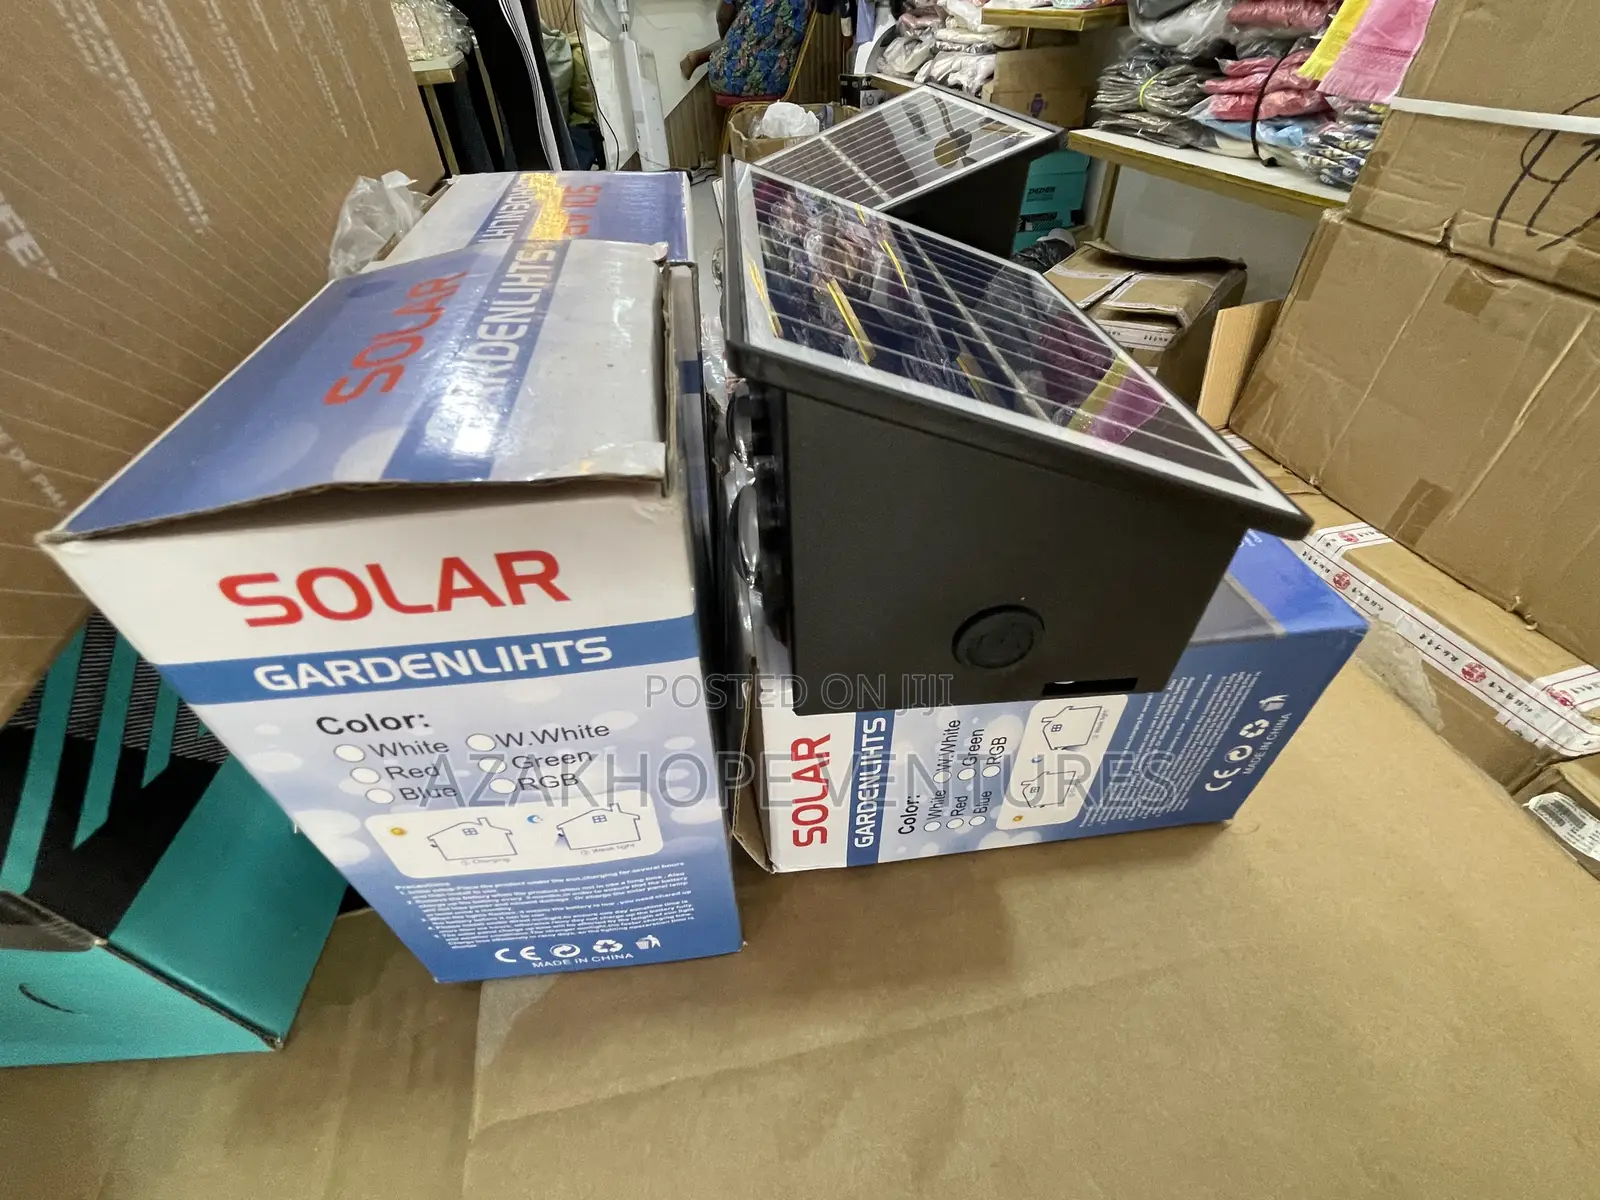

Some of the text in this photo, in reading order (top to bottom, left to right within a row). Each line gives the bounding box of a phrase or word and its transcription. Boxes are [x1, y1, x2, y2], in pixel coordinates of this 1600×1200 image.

[322, 270, 469, 406] SOLAR
[218, 550, 571, 627] SOLAR
[253, 636, 612, 692] GARDENLIHTS
[316, 713, 431, 735] Color:
[368, 722, 611, 759] White W.White
[1242, 750, 1267, 774] MADE
[1266, 712, 1293, 741] CHINA
[384, 751, 594, 780] Red Green
[399, 773, 579, 801] Blue RGB
[790, 733, 831, 848] SOLAR
[854, 717, 887, 848] GARDENLIHTS
[927, 719, 961, 821] White W.White
[951, 728, 985, 817] Red Green
[973, 736, 1007, 815] Blue RGB
[898, 794, 921, 835] Color:
[532, 952, 634, 968] MADE IN CHINA
